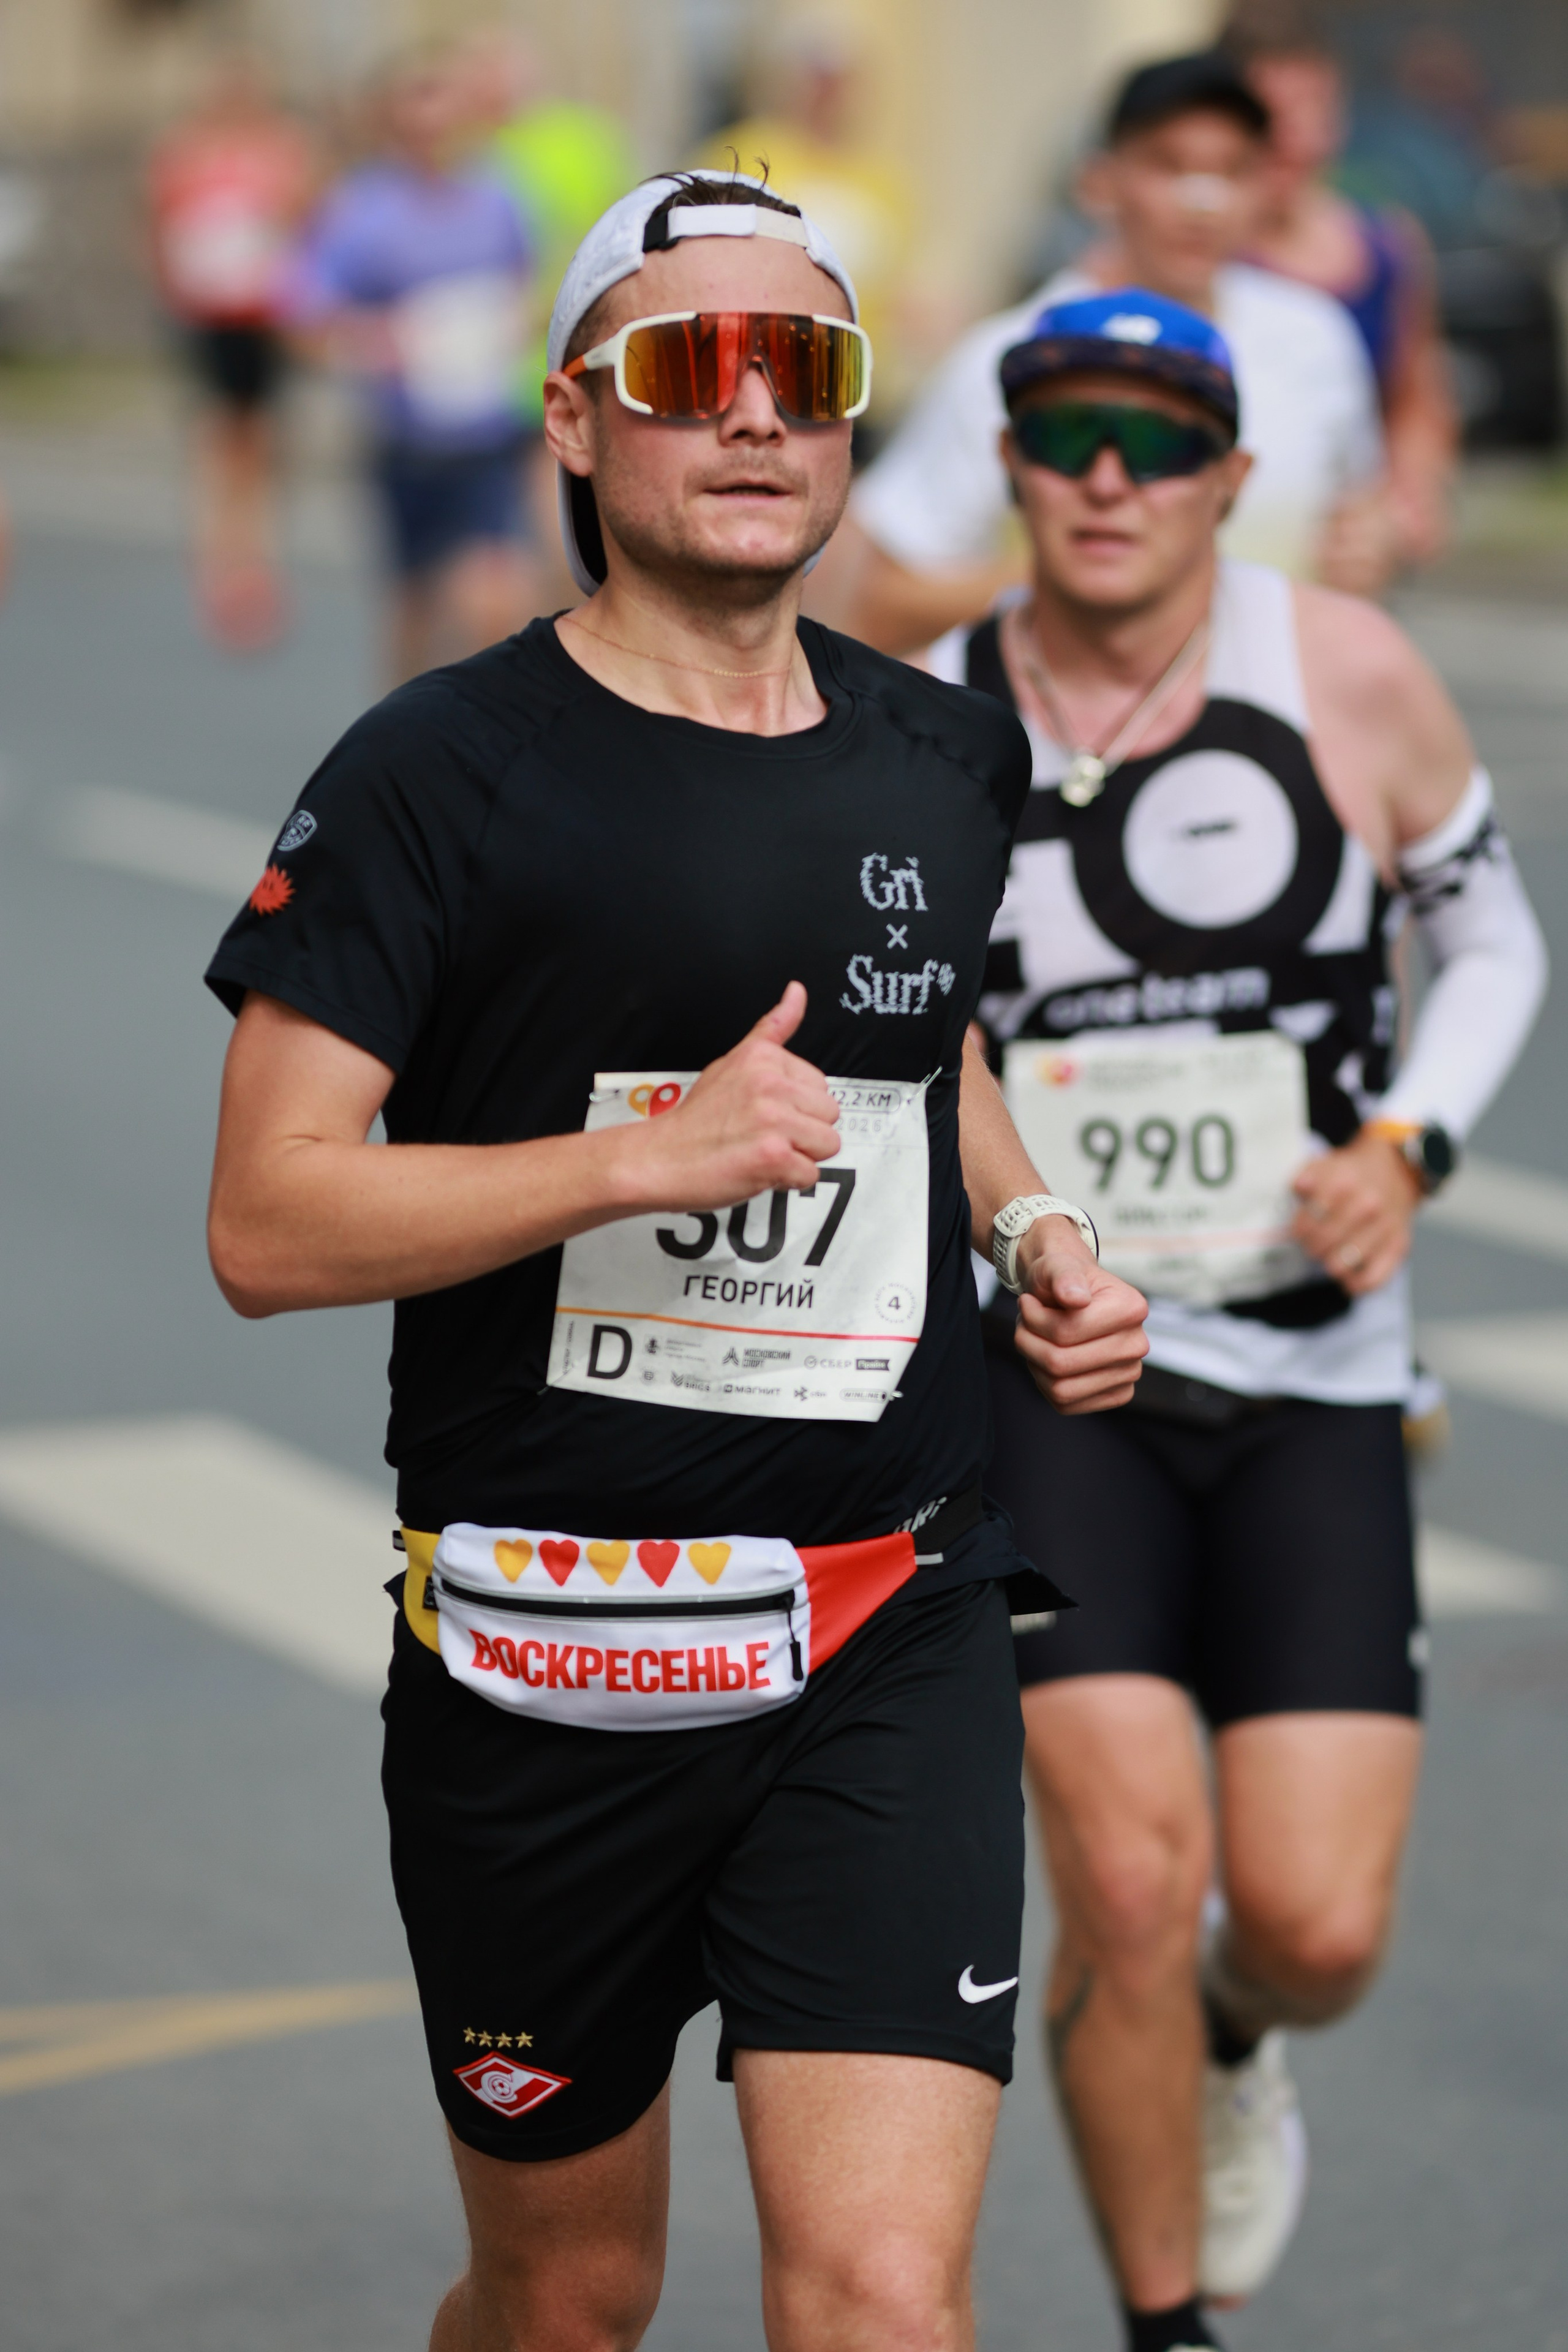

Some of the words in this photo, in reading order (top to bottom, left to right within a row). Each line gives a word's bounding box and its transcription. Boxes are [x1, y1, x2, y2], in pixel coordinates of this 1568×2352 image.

[839, 953, 939, 1015] Surf
[832, 1090, 862, 1107] 2,2
[1079, 1114, 1236, 1191] 990
[684, 1275, 813, 1308] ГЕОРГИЙ
[888, 1295, 901, 1310] 4
[587, 1324, 632, 1379] D
[470, 1629, 772, 1694] ВОСКРЕСЕНЬЕ
